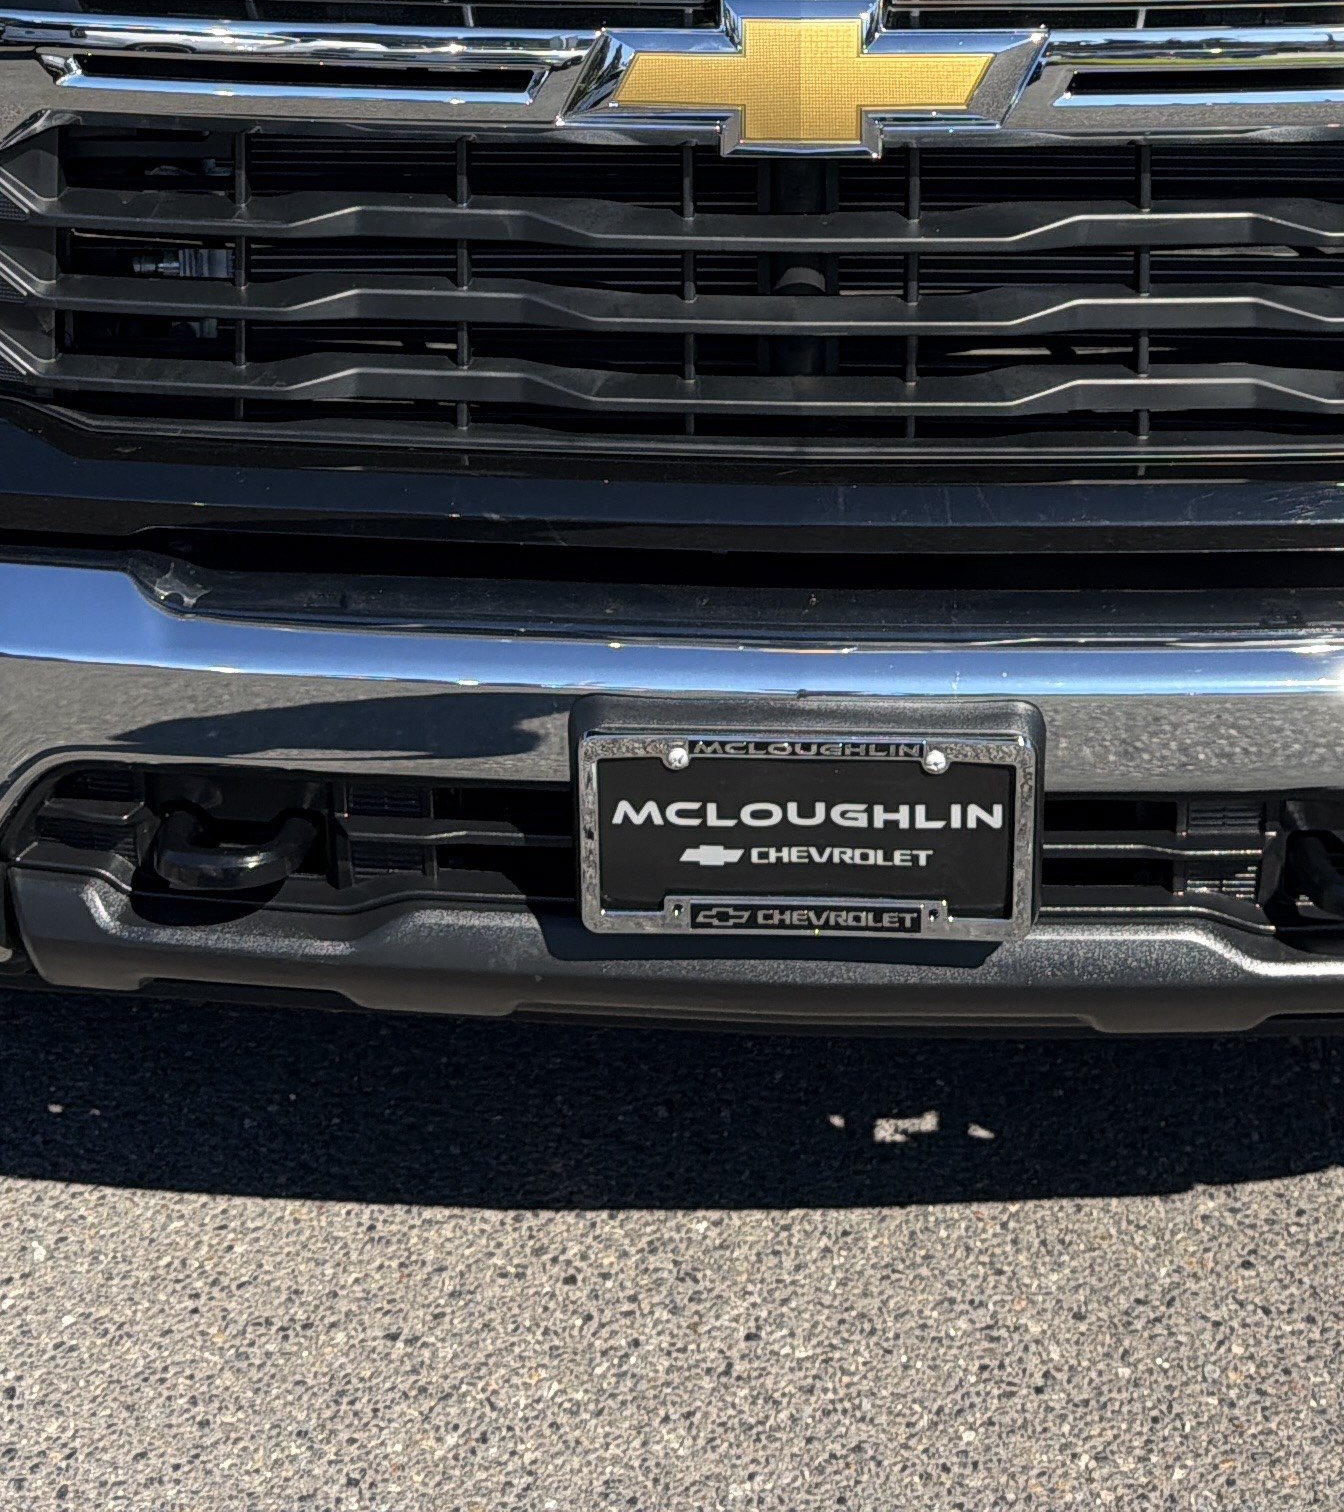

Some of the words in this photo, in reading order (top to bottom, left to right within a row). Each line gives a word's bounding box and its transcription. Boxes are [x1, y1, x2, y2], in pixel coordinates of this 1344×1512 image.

[693, 740, 920, 757] MCLOUGHLIN
[612, 800, 1002, 829] MCLOUGHLIN
[750, 846, 934, 867] CHEVROLET
[756, 909, 918, 929] CHEVROLET
